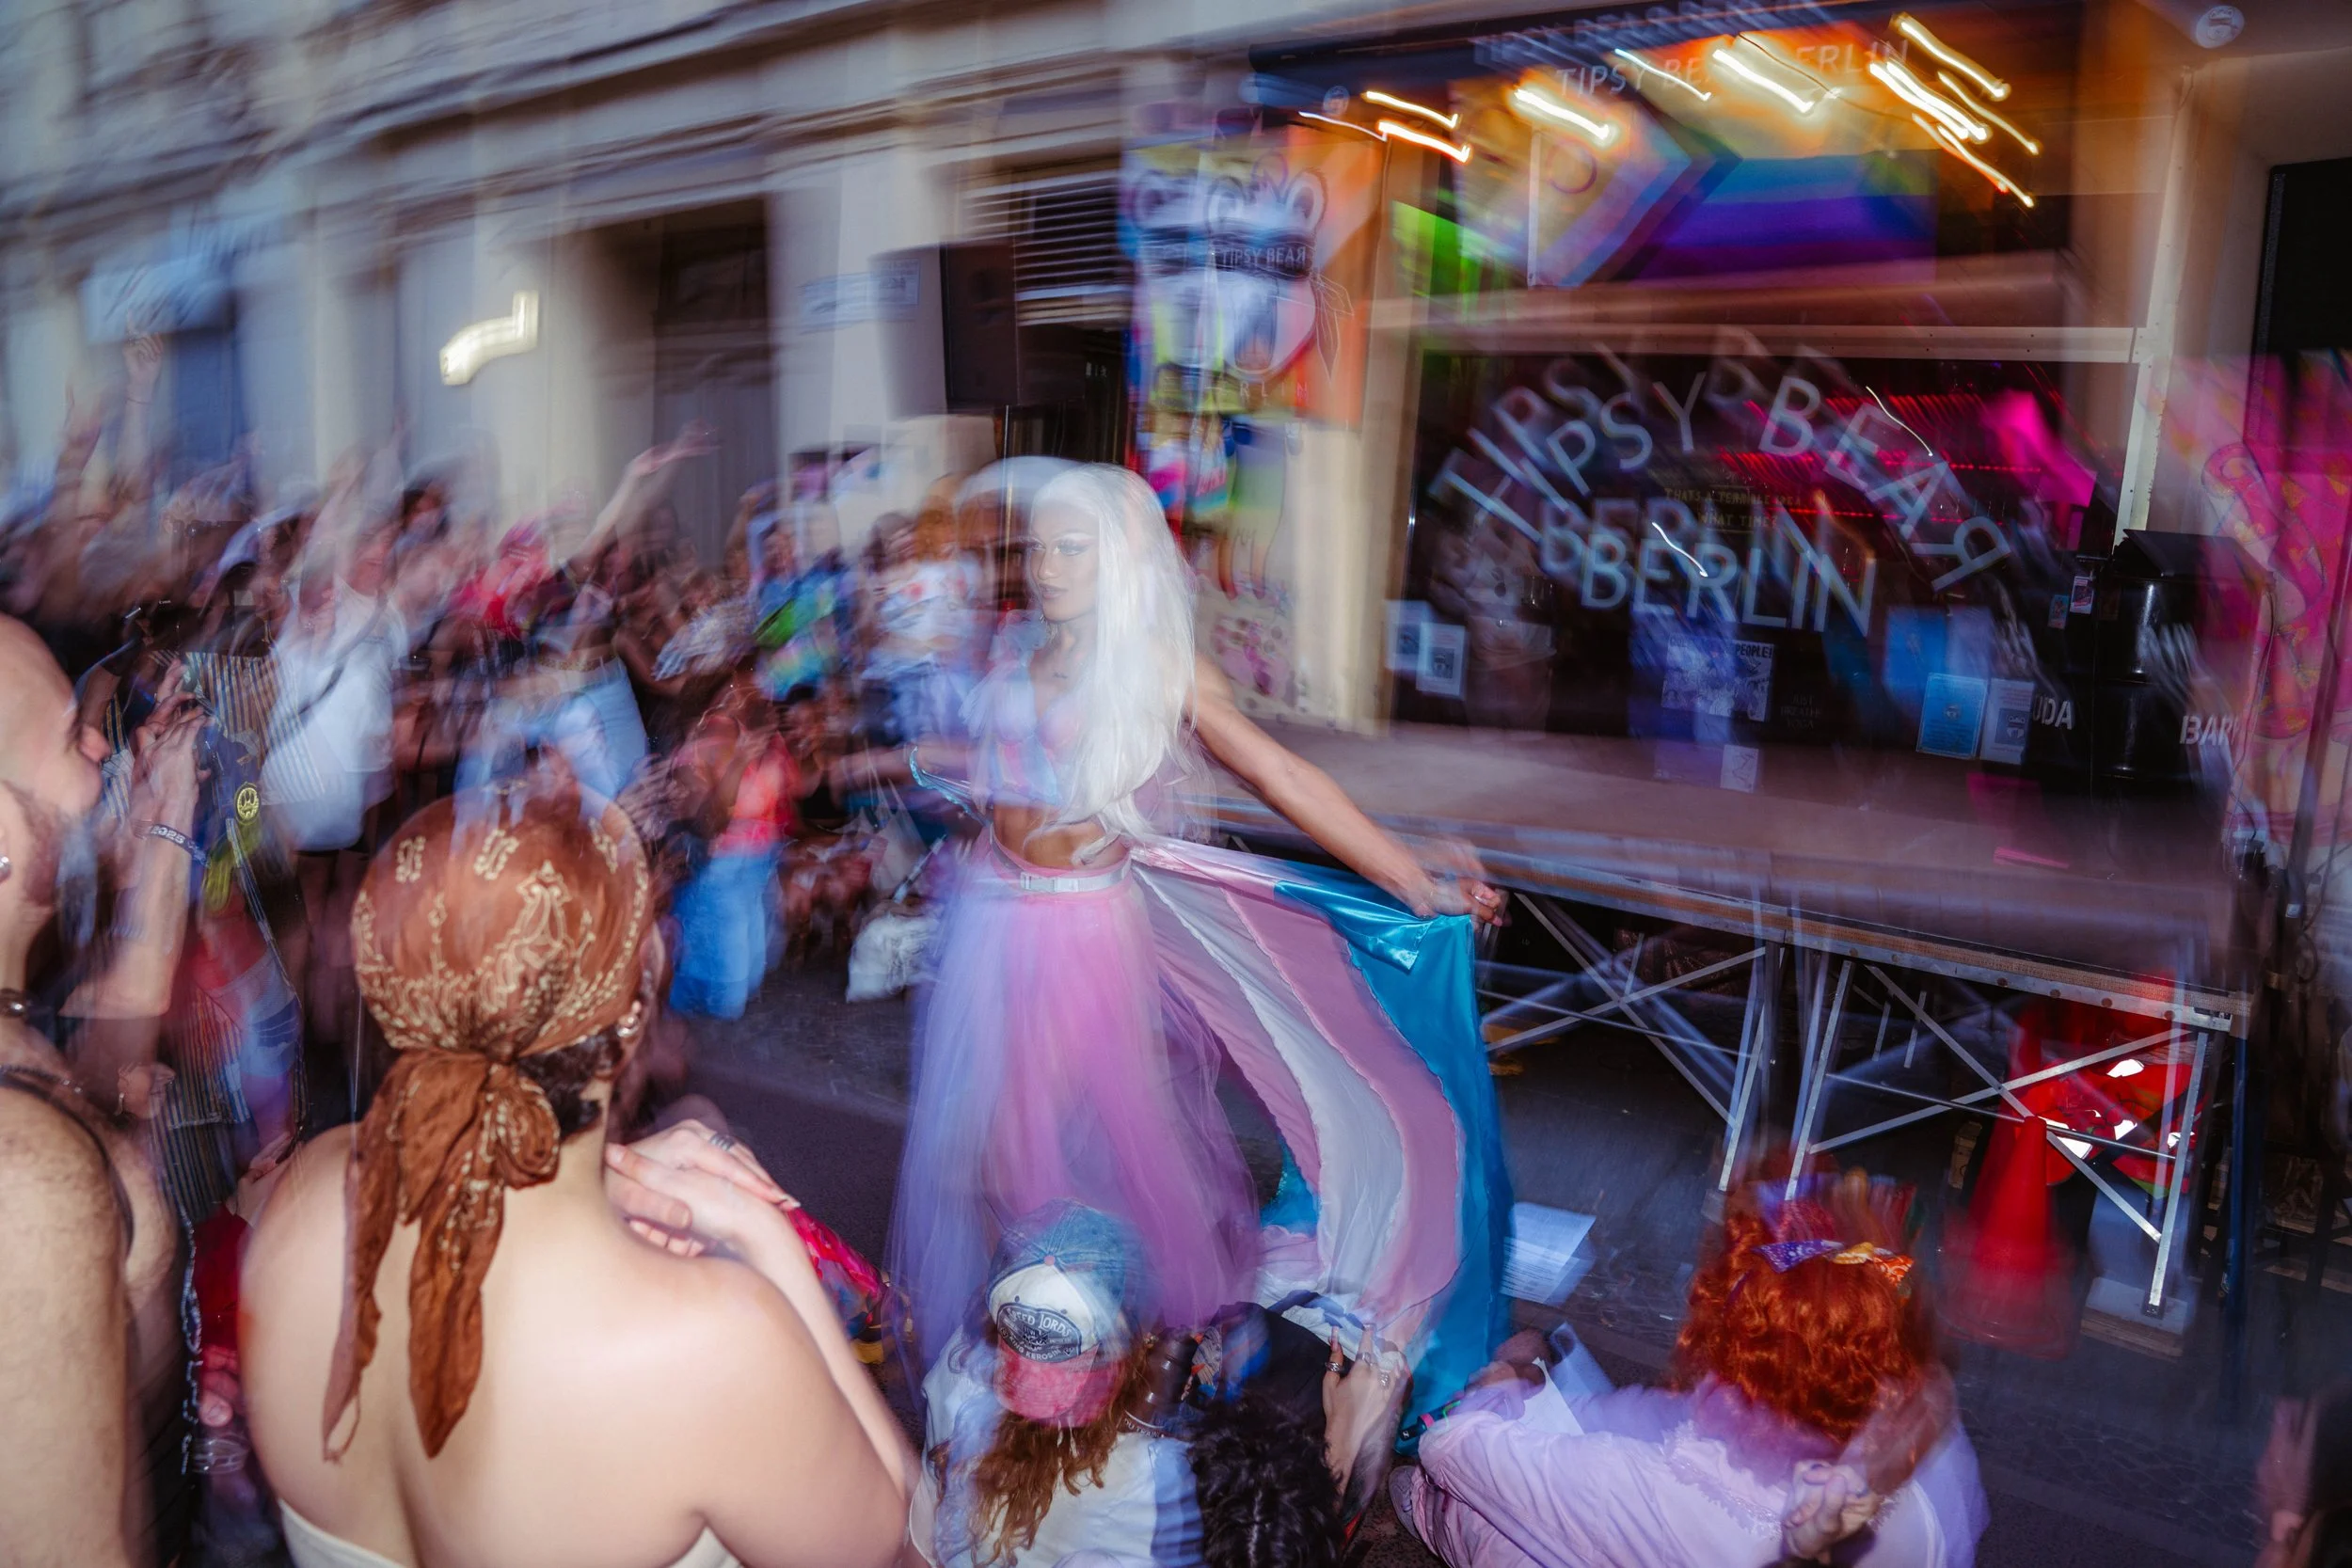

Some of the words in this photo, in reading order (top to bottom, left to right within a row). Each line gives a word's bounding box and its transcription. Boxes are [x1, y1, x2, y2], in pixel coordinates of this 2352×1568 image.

[1556, 58, 1651, 99] TIPSY
[1222, 247, 1262, 266] TIPSY
[1449, 371, 1707, 543] TIPSY
[1581, 532, 1878, 640] BERLIN
[151, 825, 186, 845] 2025
[1038, 1313, 1073, 1337] LORDS
[1009, 1336, 1025, 1354] KING
